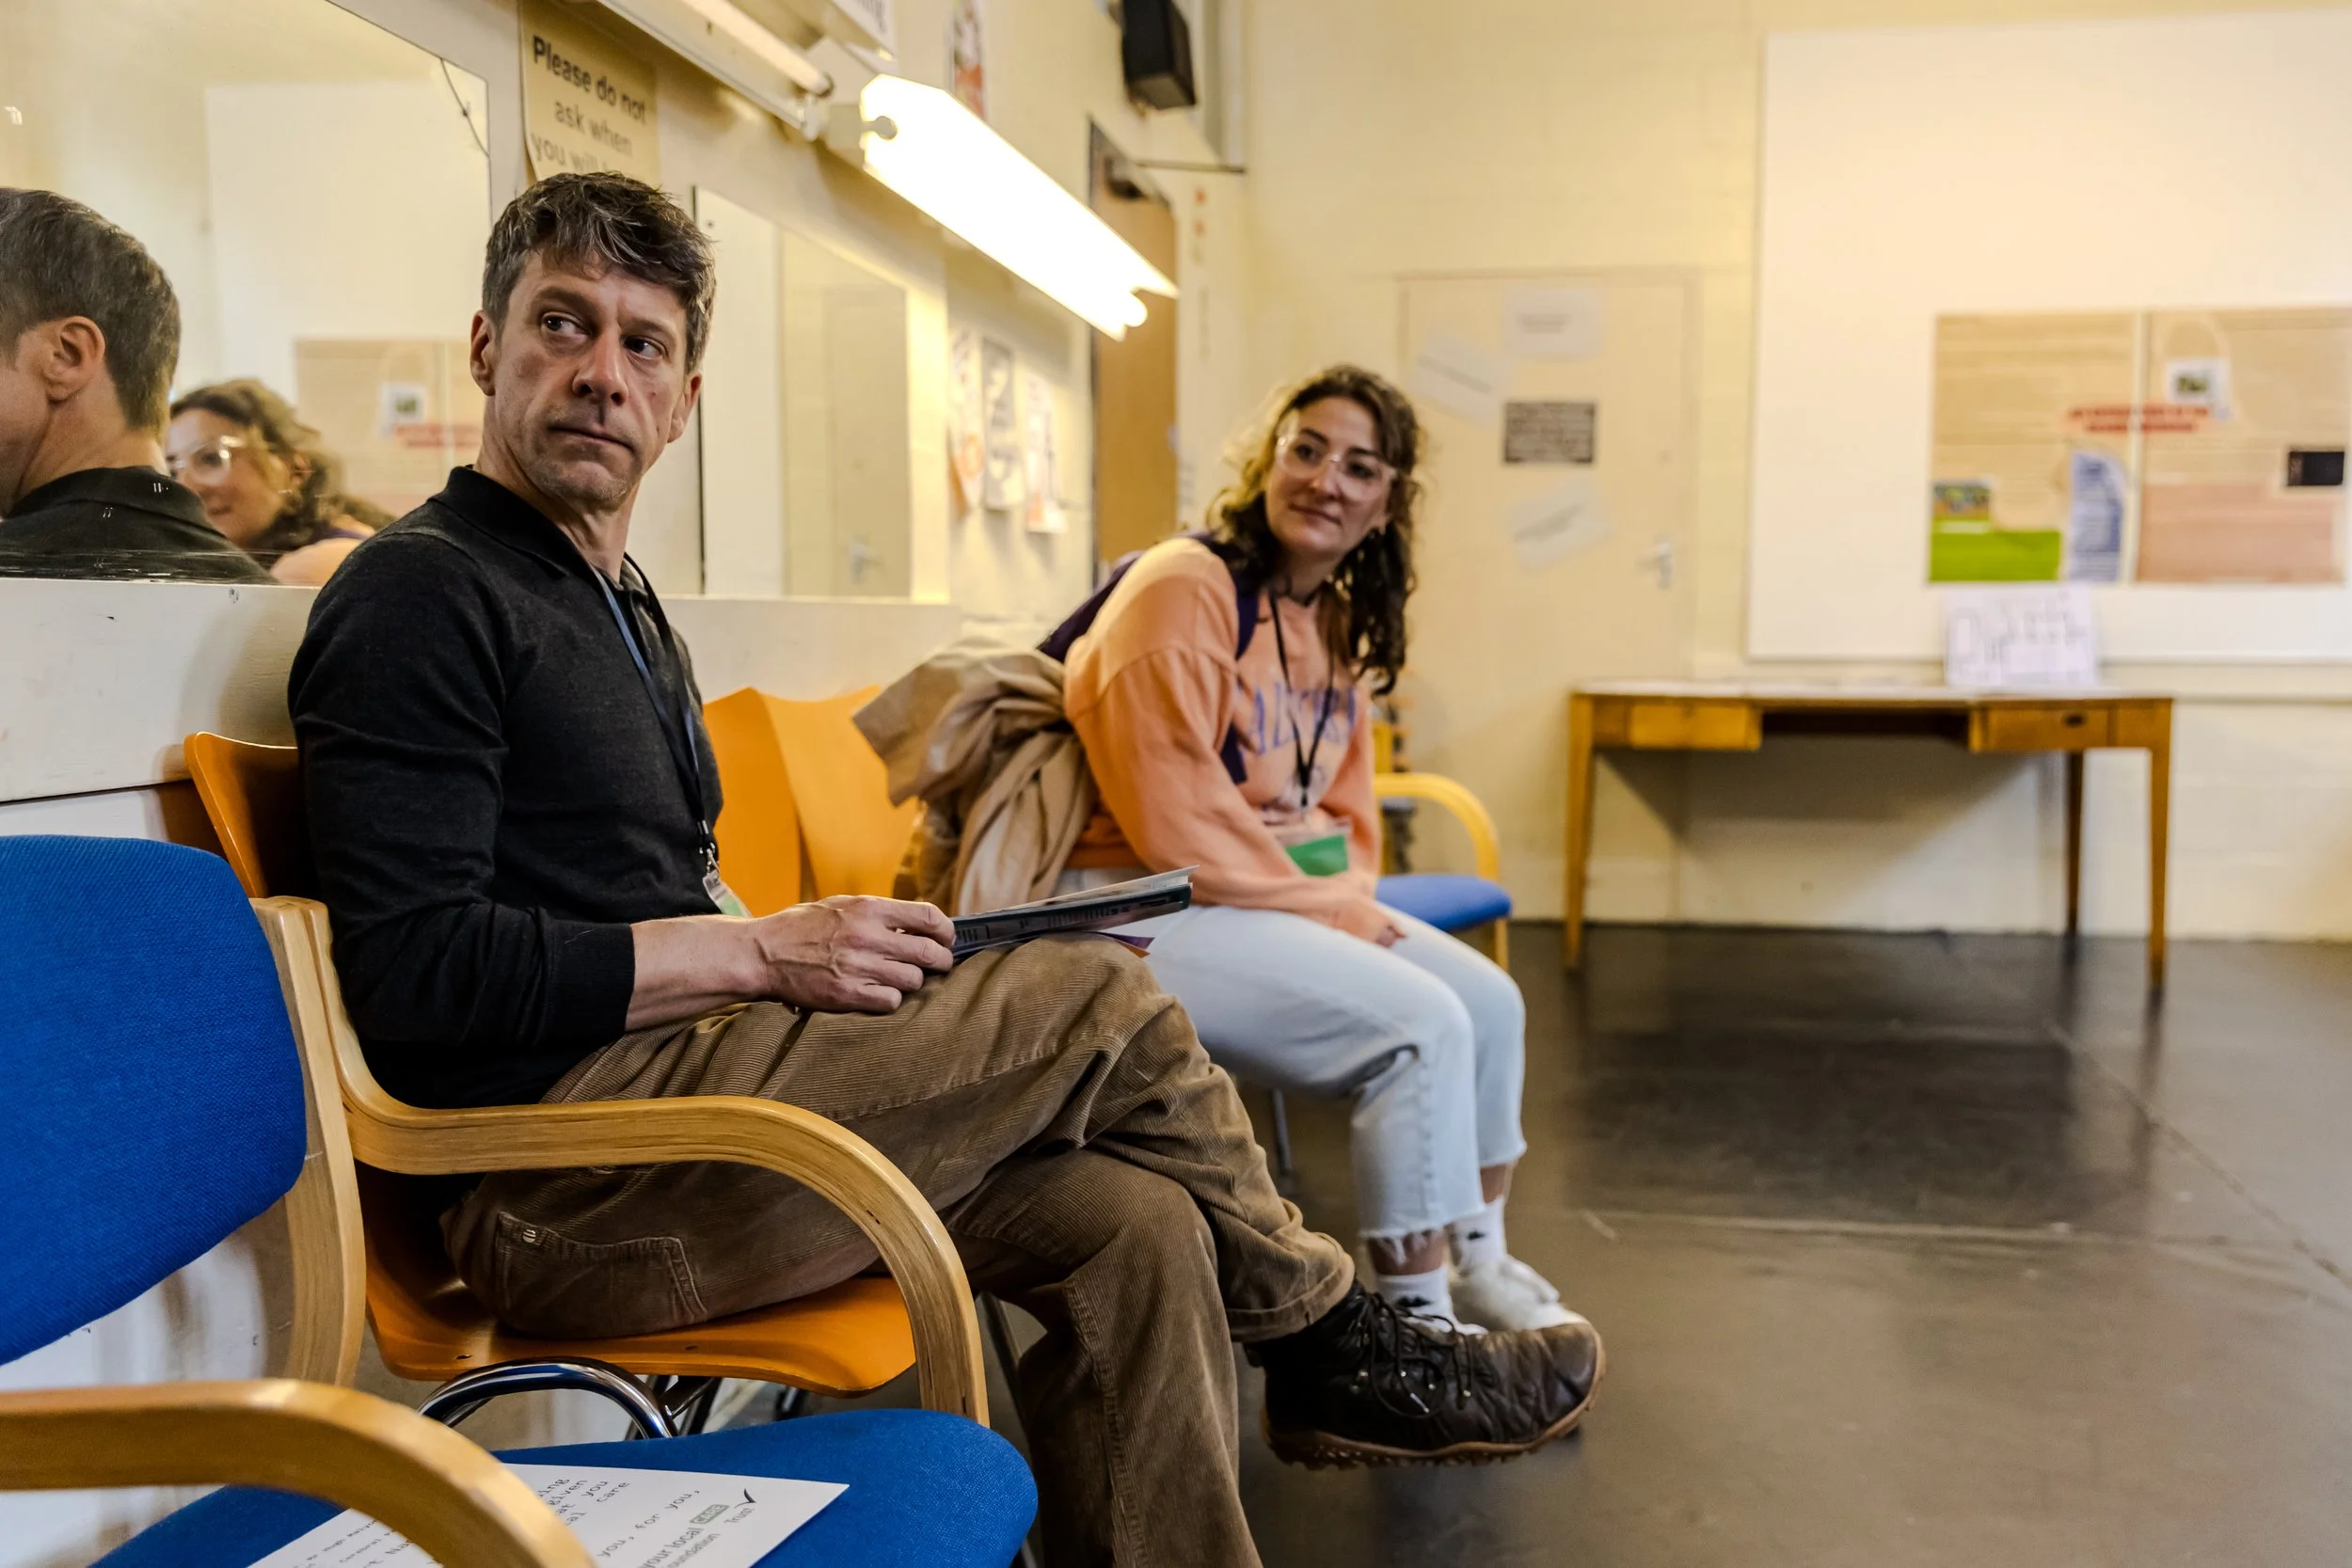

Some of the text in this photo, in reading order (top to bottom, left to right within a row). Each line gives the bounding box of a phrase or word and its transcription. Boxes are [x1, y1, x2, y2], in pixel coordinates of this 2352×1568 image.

[533, 35, 646, 125] Please do not
[554, 101, 633, 159] ask when
[531, 132, 566, 166] you
[548, 1480, 588, 1506] given
[580, 1481, 609, 1497] you
[596, 1482, 630, 1502] care
[596, 1490, 700, 1558] you, for you,
[663, 1527, 704, 1548] local
[665, 1507, 755, 1568] oundation Trust
